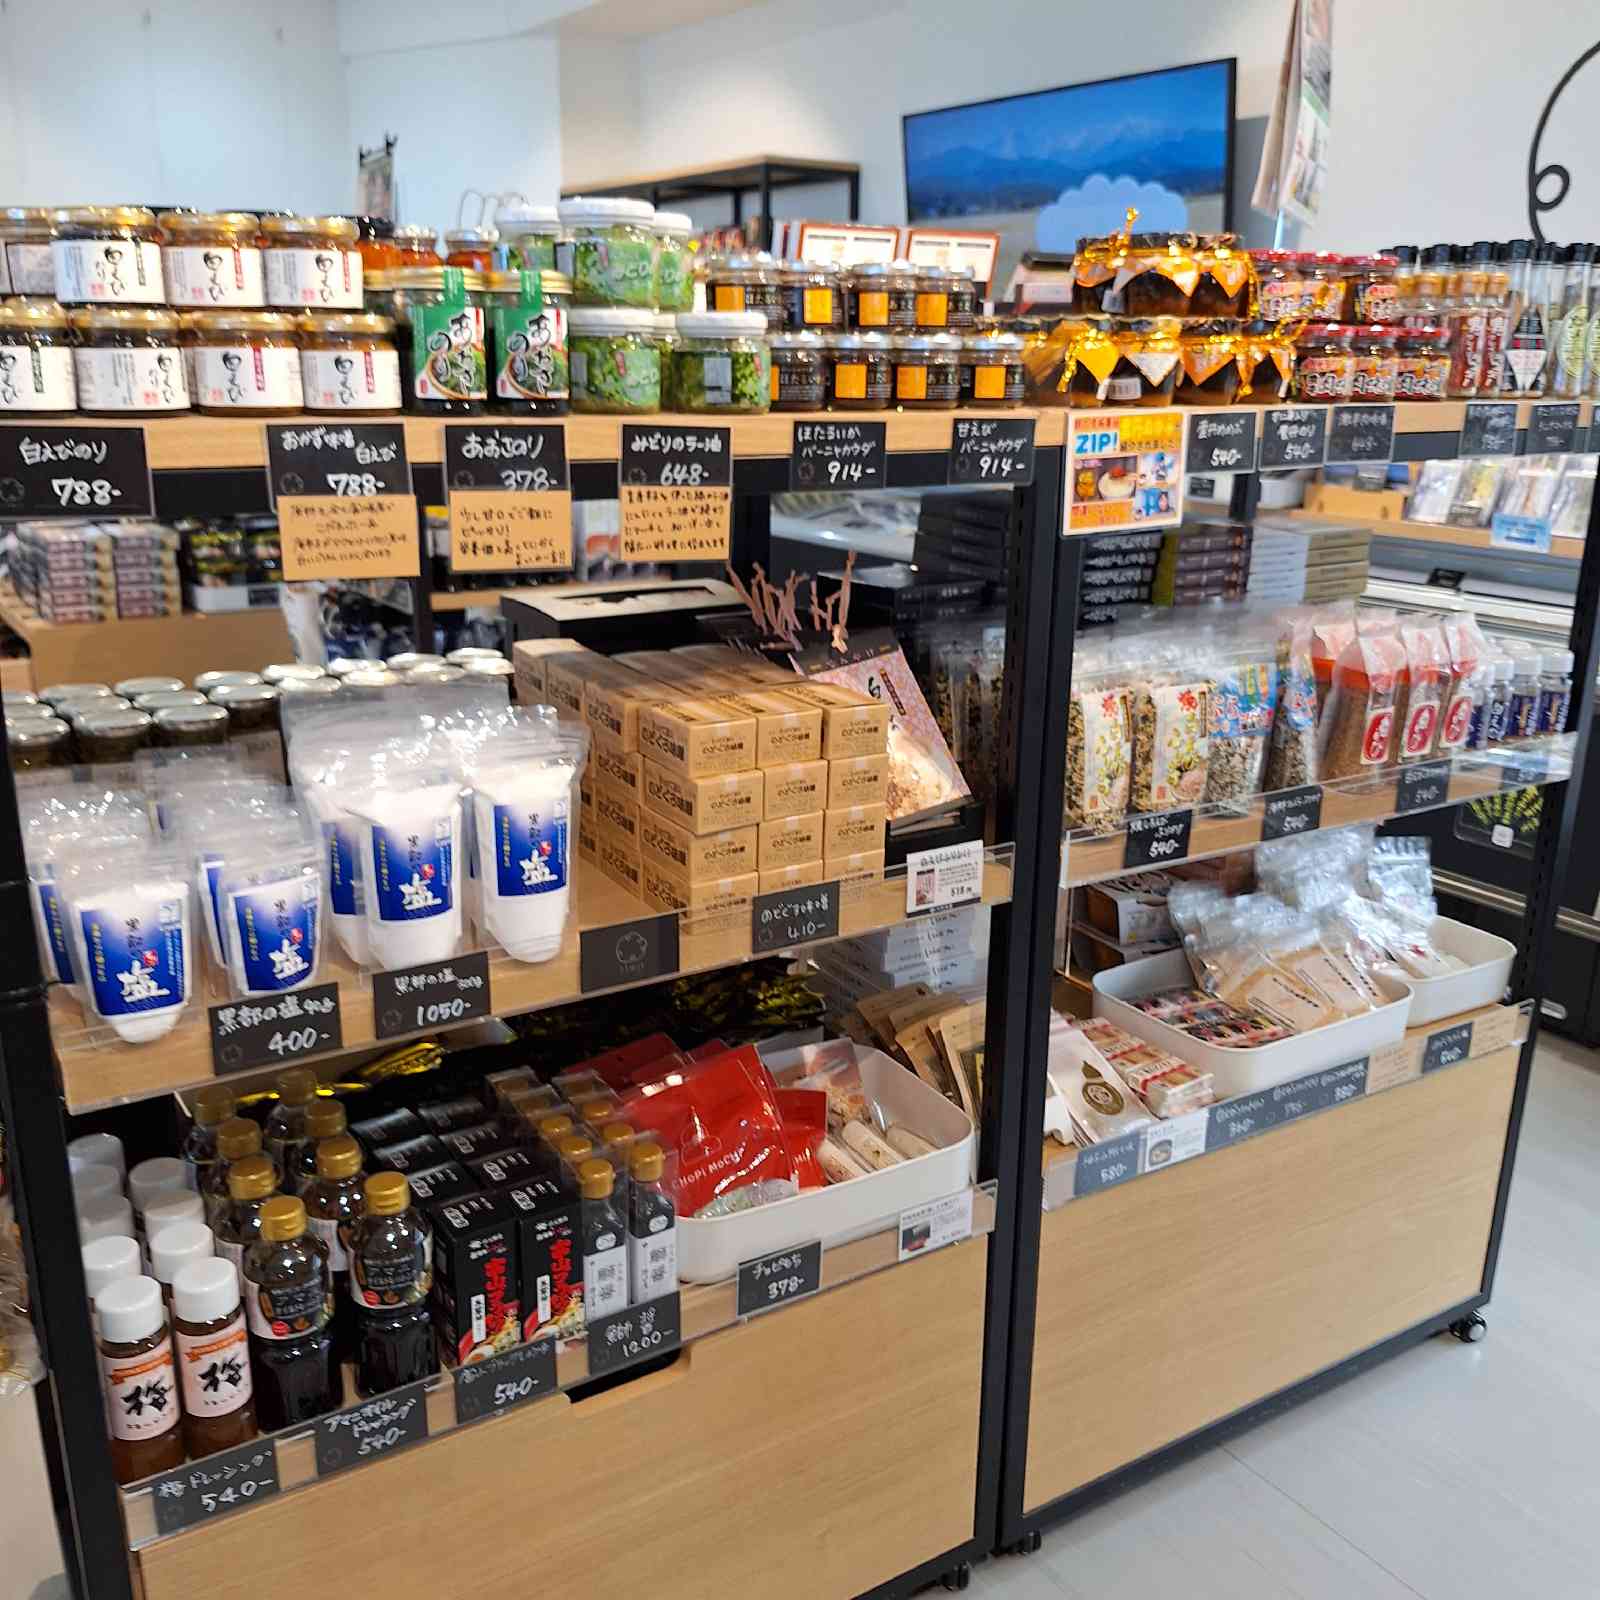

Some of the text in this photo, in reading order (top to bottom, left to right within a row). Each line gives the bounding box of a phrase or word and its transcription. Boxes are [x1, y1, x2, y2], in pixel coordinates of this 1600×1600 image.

[462, 429, 545, 460] あおさのり
[1075, 432, 1119, 455] ZIP!
[660, 462, 710, 486] 648-
[978, 456, 1026, 479] 914-
[51, 476, 123, 507] 788-
[416, 998, 473, 1026] 1050-
[268, 1028, 332, 1056] 400-
[200, 1478, 276, 1513] 540-
